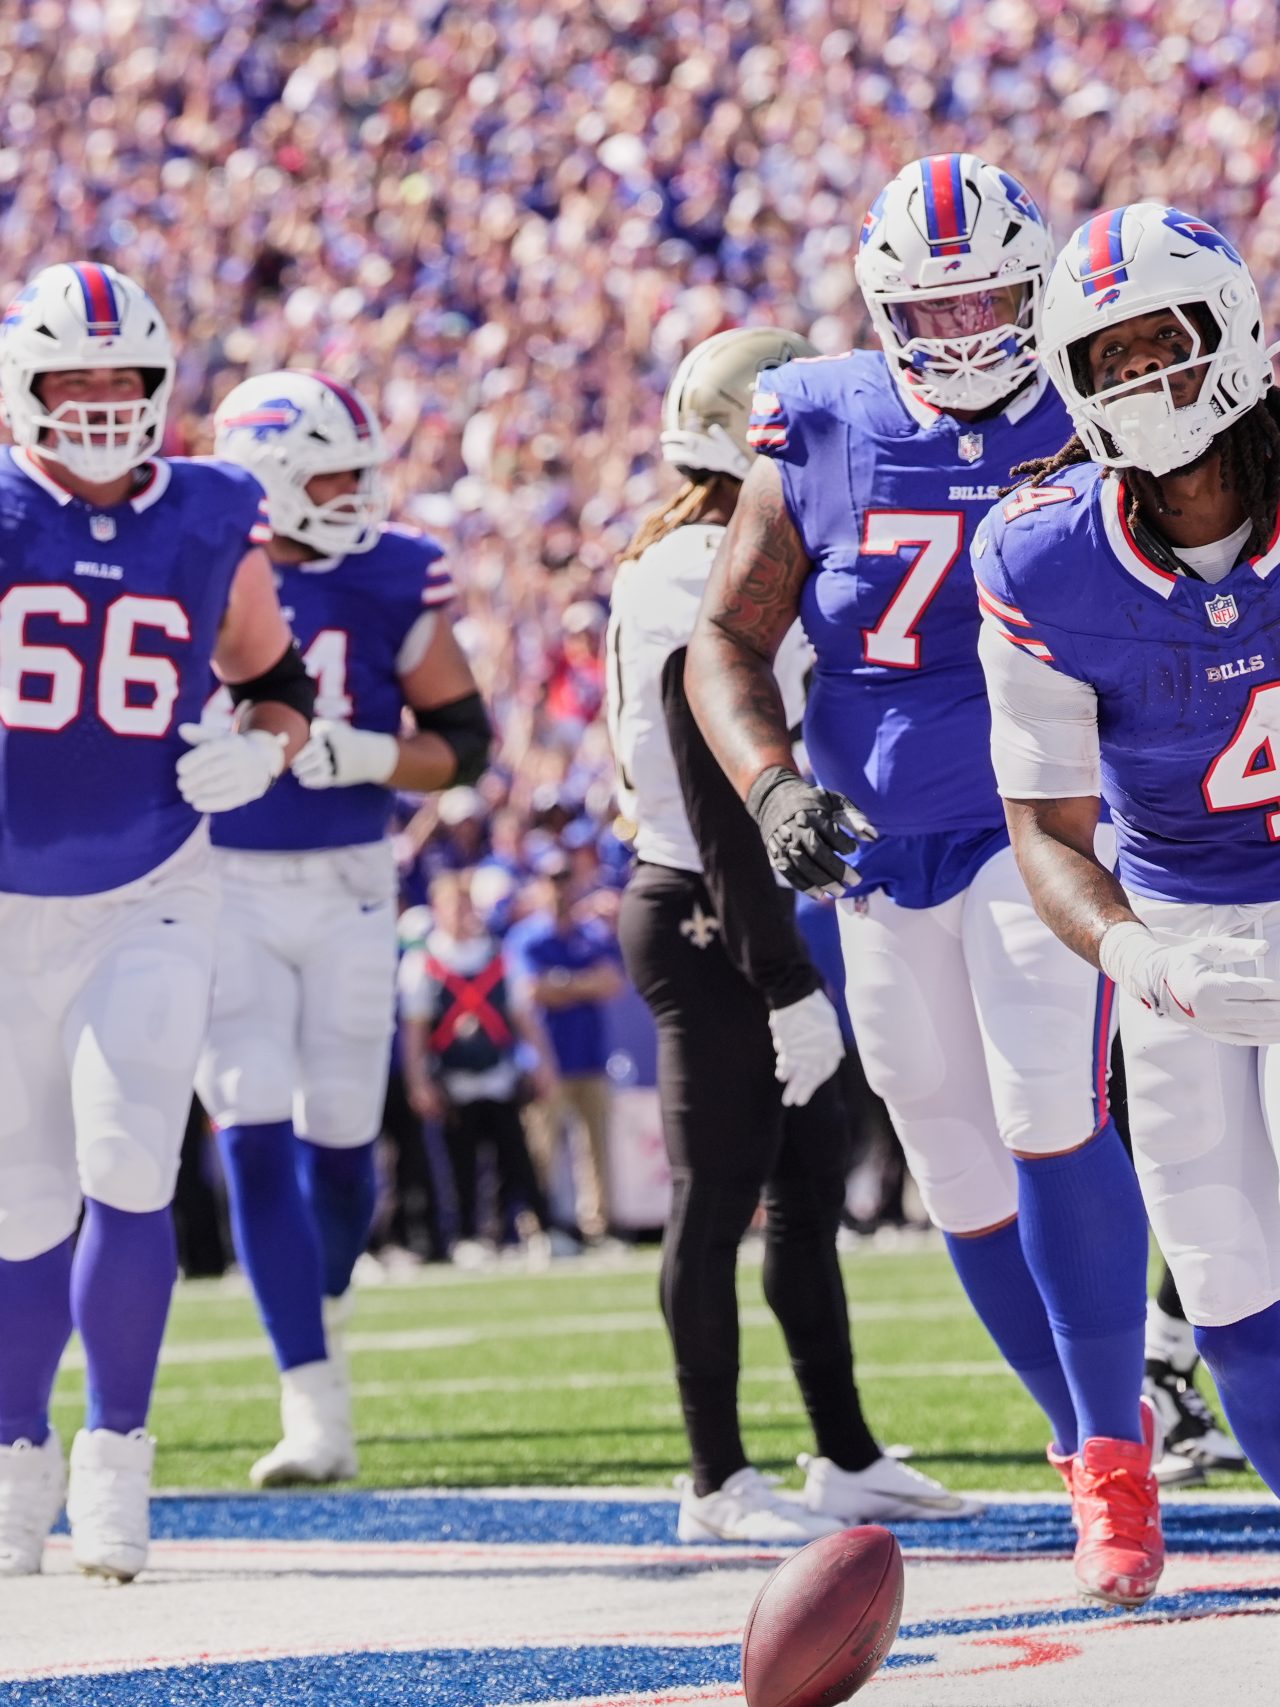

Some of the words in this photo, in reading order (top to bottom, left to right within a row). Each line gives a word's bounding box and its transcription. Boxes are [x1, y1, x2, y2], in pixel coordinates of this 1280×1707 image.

[948, 485, 1001, 500] BILLS
[1003, 485, 1077, 524] 4
[74, 560, 124, 580] BILLS
[860, 508, 966, 670] 7
[0, 582, 192, 739] 66
[1205, 654, 1265, 683] BILLS
